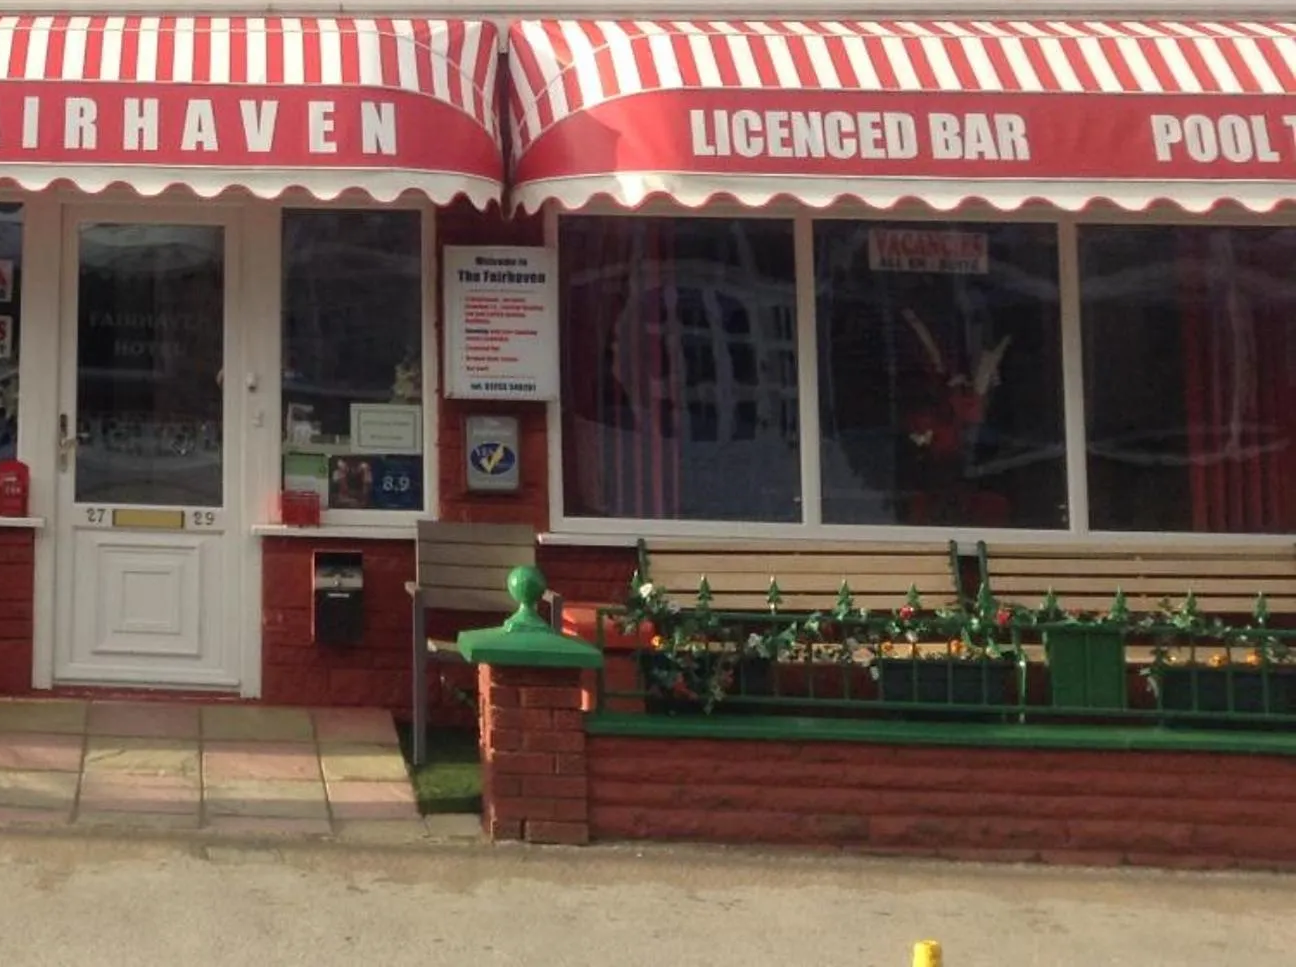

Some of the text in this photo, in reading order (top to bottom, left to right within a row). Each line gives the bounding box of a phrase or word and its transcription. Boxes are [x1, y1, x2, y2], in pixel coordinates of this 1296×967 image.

[690, 109, 1031, 161] LICENCED BAR
[1150, 113, 1281, 164] POOL
[457, 270, 546, 284] The Fairhaven
[381, 475, 410, 493] 8.9
[86, 507, 106, 523] 27
[193, 511, 215, 527] 29
